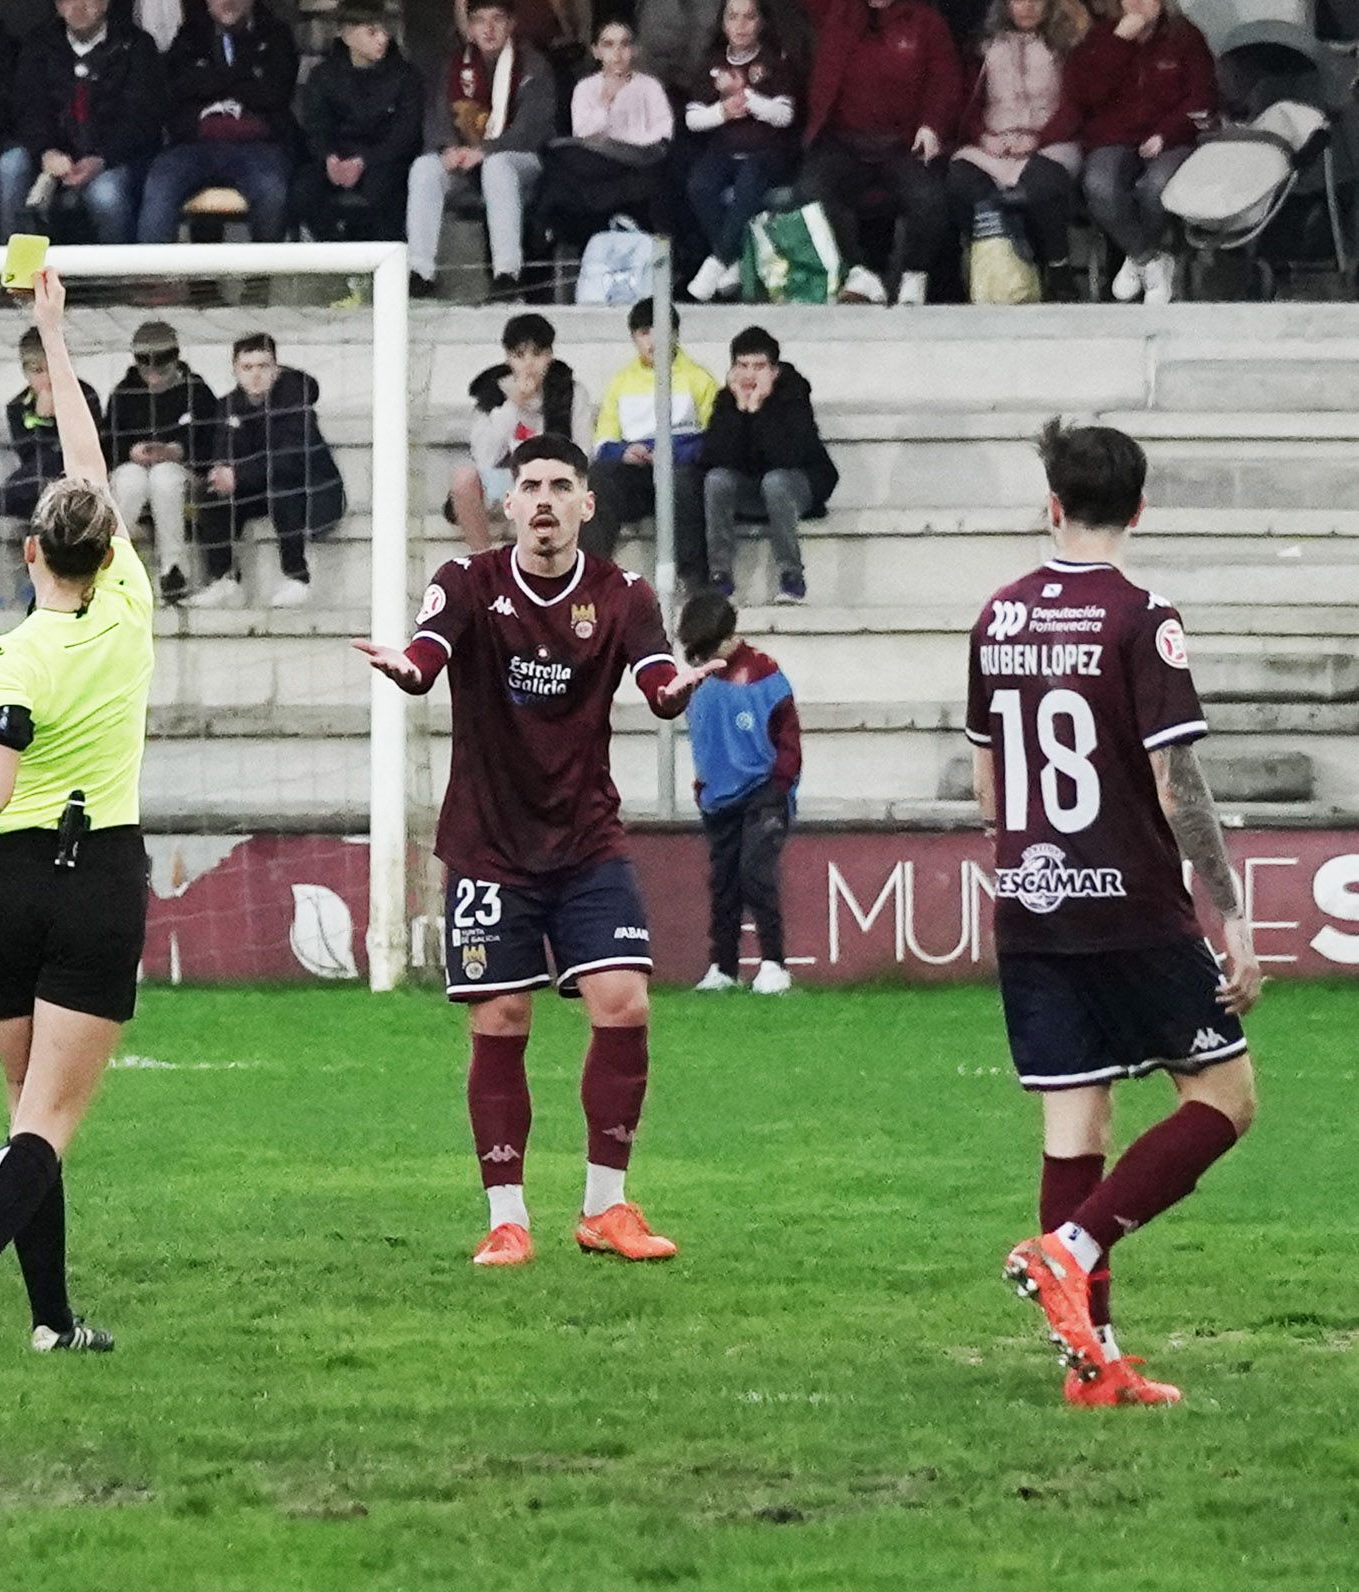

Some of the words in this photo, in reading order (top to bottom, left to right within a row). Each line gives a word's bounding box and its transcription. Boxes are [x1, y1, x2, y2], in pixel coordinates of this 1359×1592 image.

[1029, 620, 1102, 634] Pontevedra
[1032, 605, 1106, 621] Deputación
[509, 656, 572, 680] Estrella
[980, 644, 1038, 676] RUBEN
[1041, 644, 1103, 676] LOPEZ
[508, 672, 567, 695] Galicia
[990, 689, 1101, 834] 18
[453, 878, 502, 928] 23
[828, 860, 996, 964] MUN
